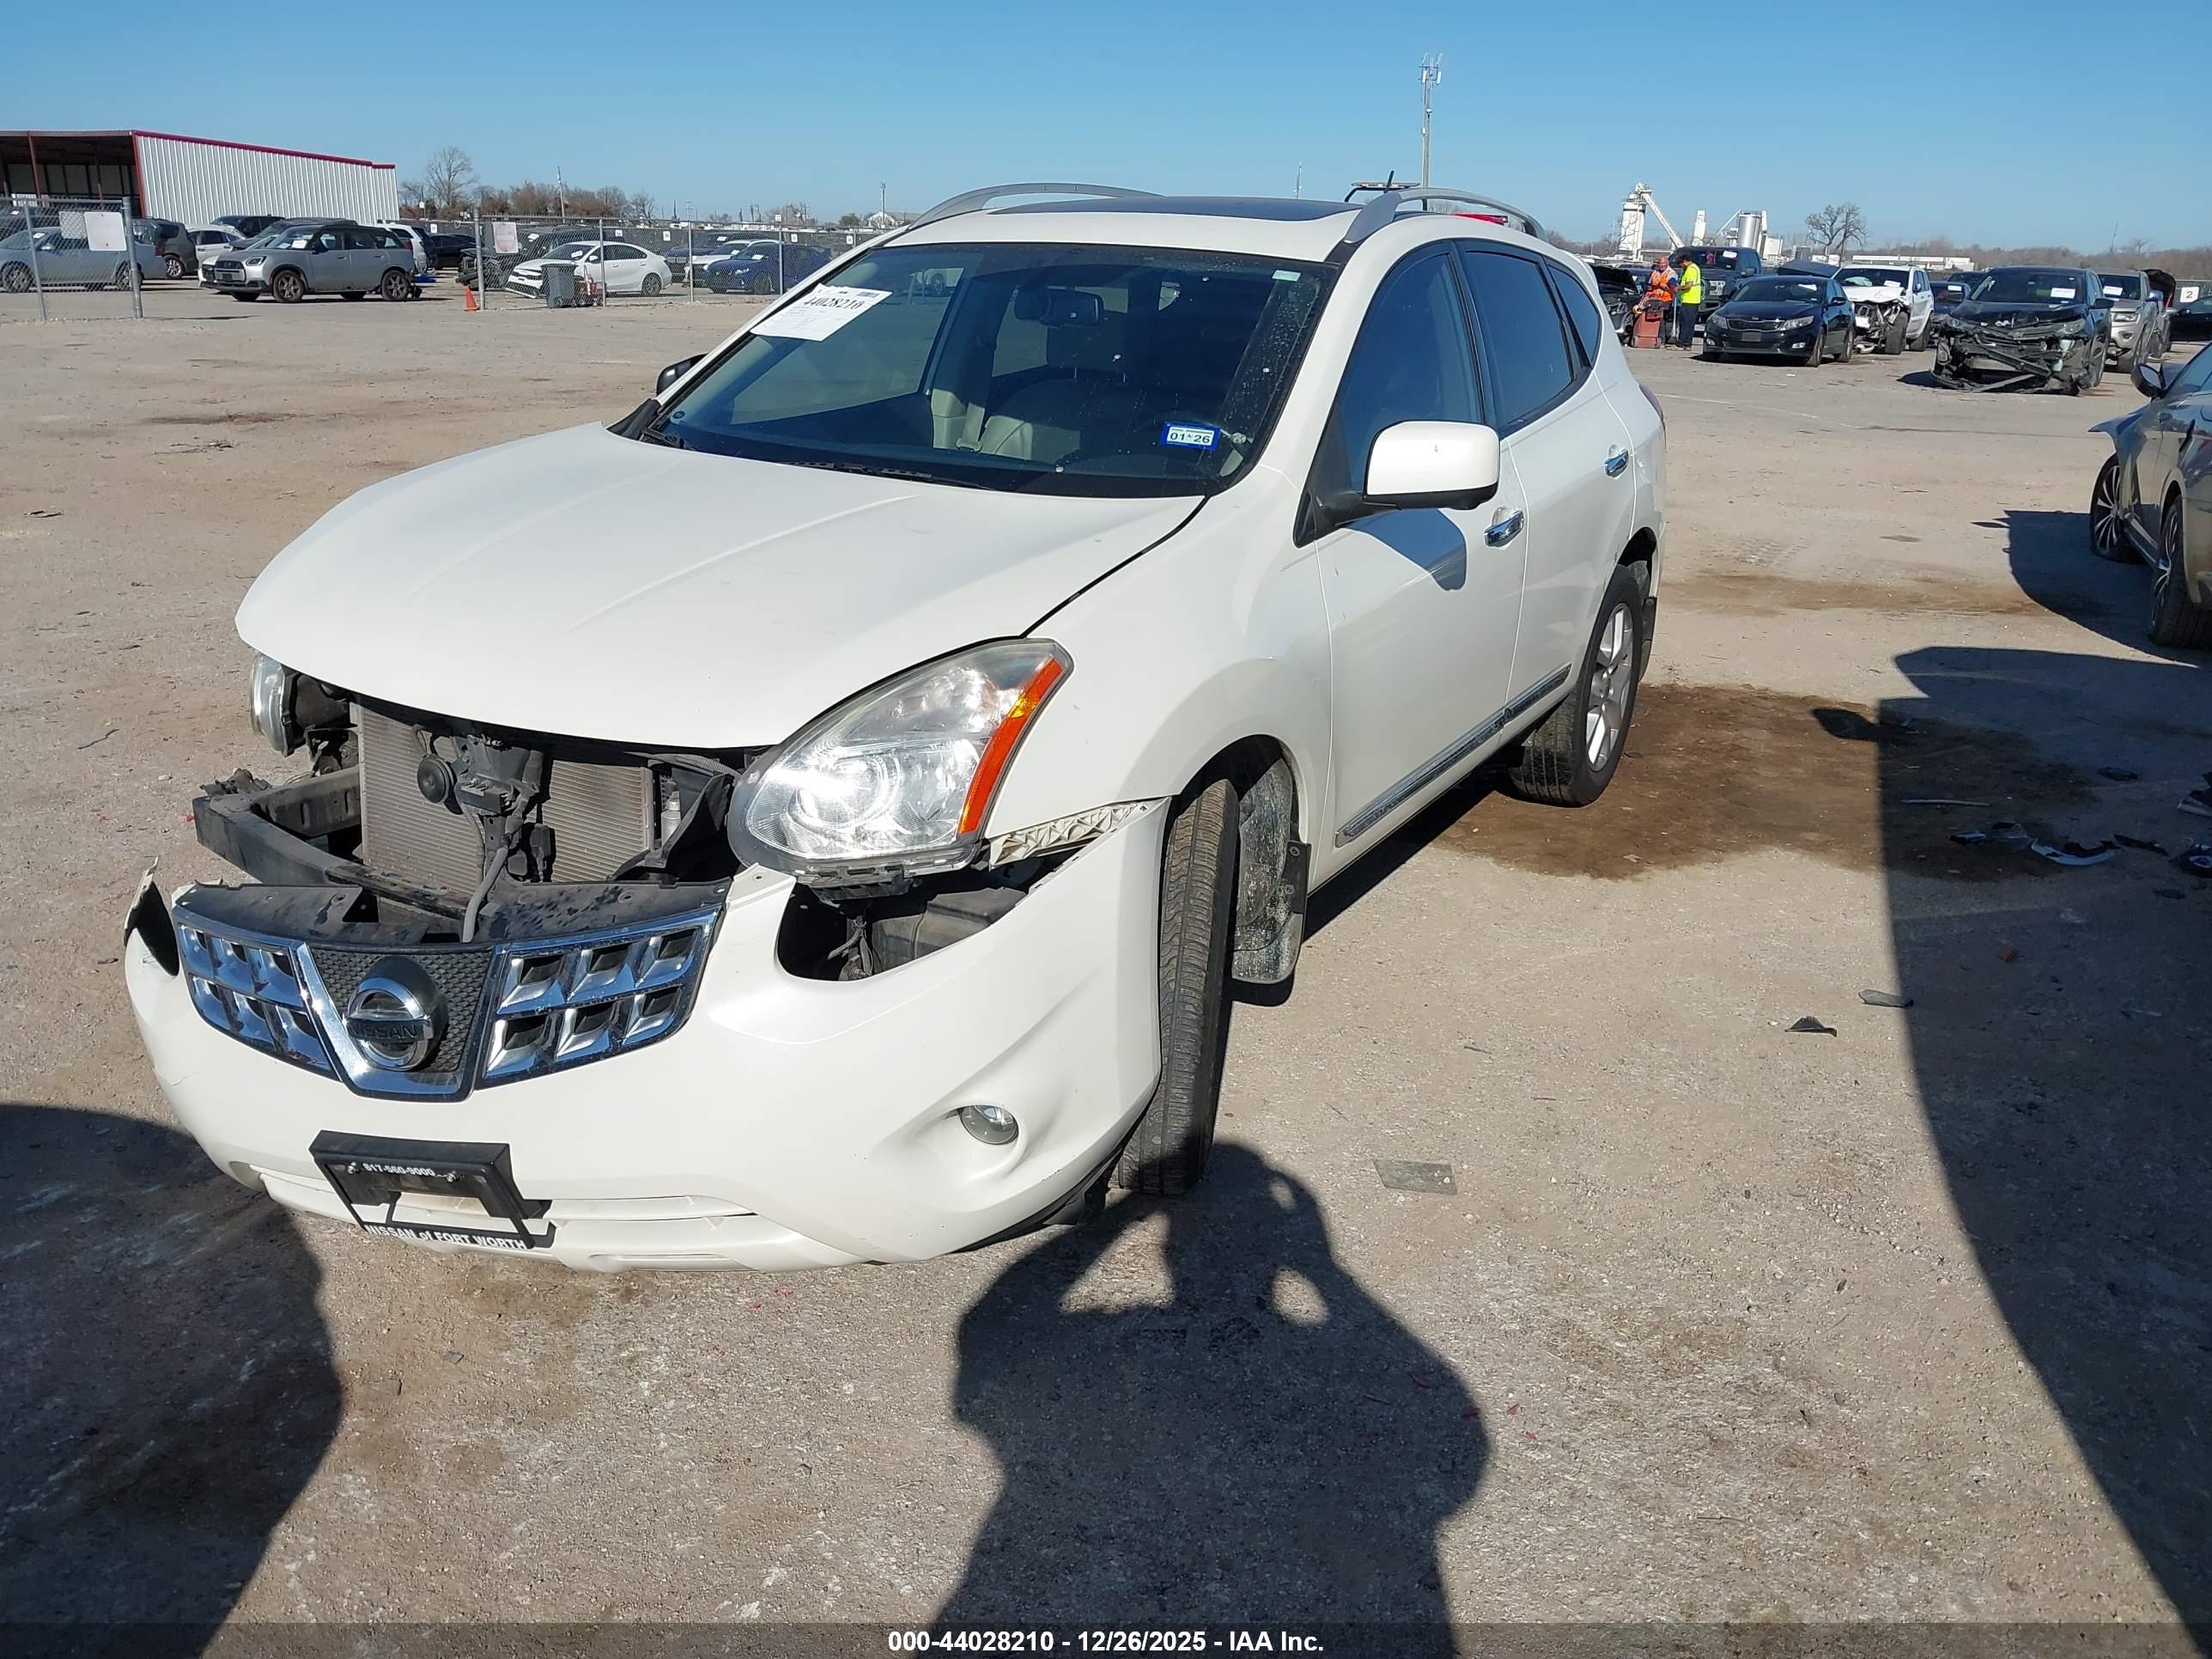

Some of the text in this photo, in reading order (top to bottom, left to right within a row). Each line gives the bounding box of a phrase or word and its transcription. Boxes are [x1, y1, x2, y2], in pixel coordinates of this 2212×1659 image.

[2185, 290, 2193, 299] 2
[349, 1024, 420, 1039] NISSAN
[365, 1224, 528, 1249] NISSAN of FORT WORTH
